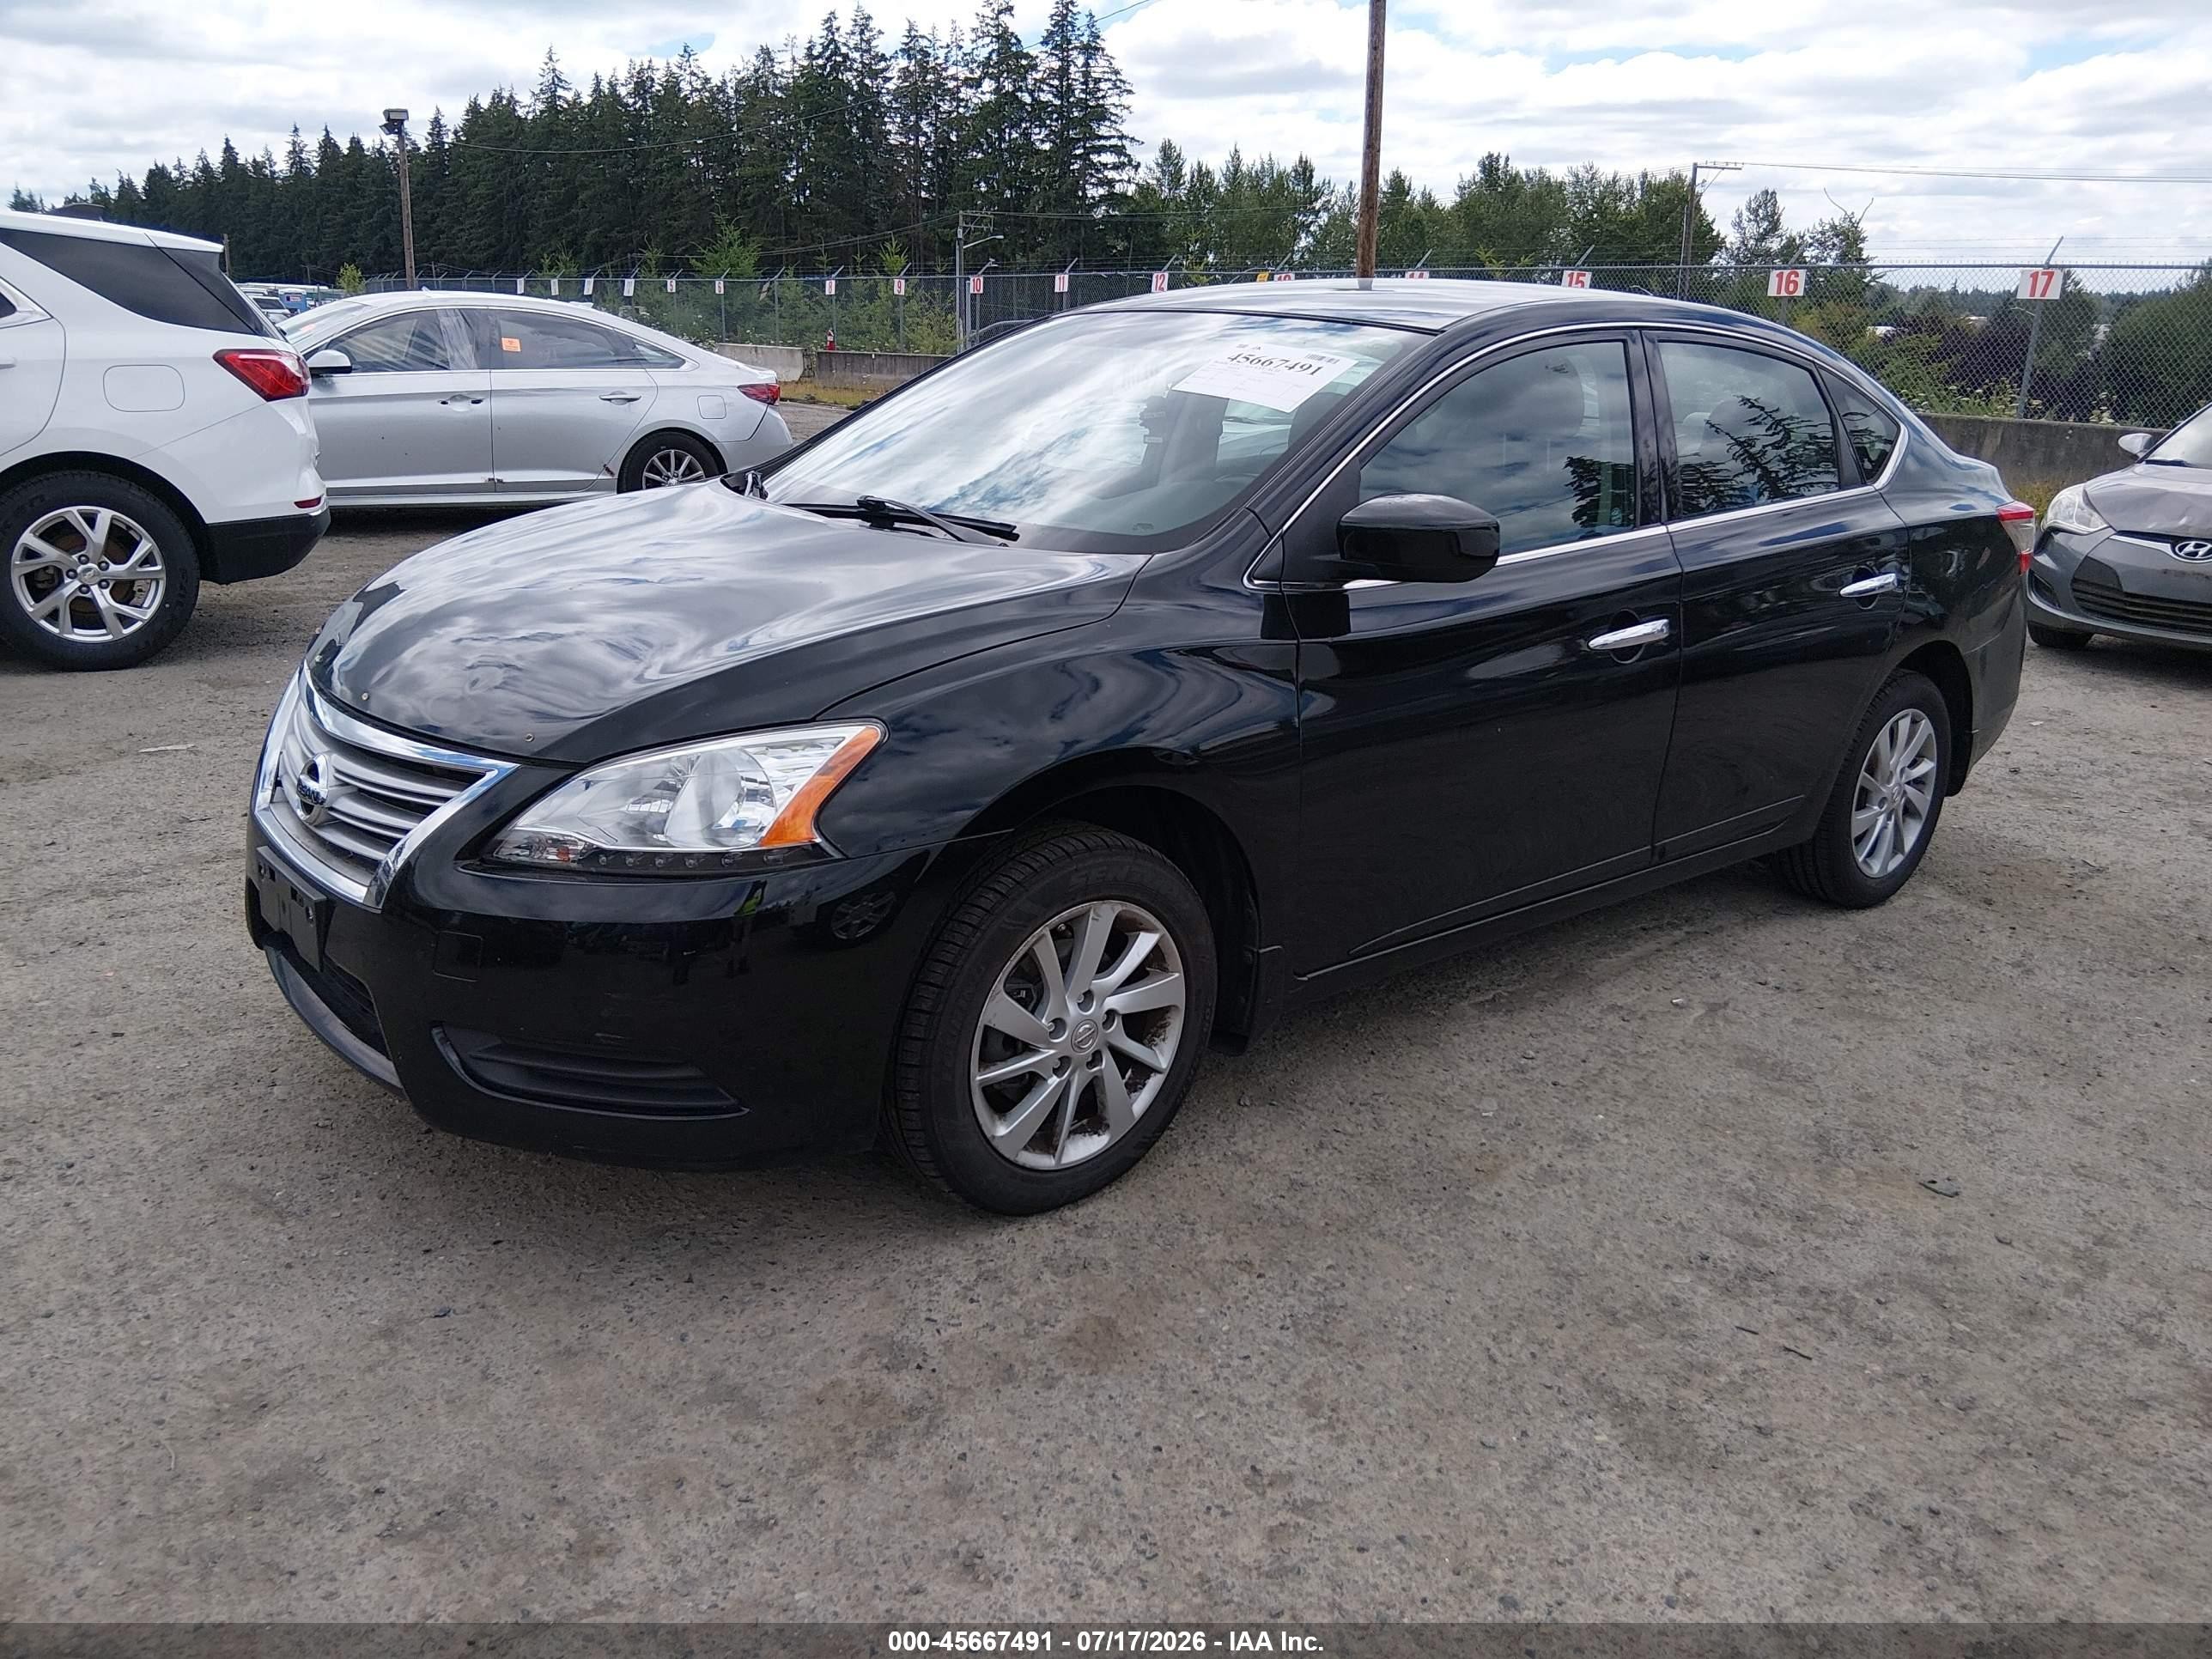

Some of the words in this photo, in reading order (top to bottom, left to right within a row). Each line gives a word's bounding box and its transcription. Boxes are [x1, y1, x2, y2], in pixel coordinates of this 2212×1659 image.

[896, 281, 902, 294] 9
[972, 278, 981, 293] 10
[1059, 276, 1066, 291] 11
[1155, 274, 1166, 292] 12
[1567, 271, 1587, 289] 15
[1776, 270, 1800, 295] 16
[2029, 270, 2055, 298] 17
[1227, 353, 1324, 376] 45667491
